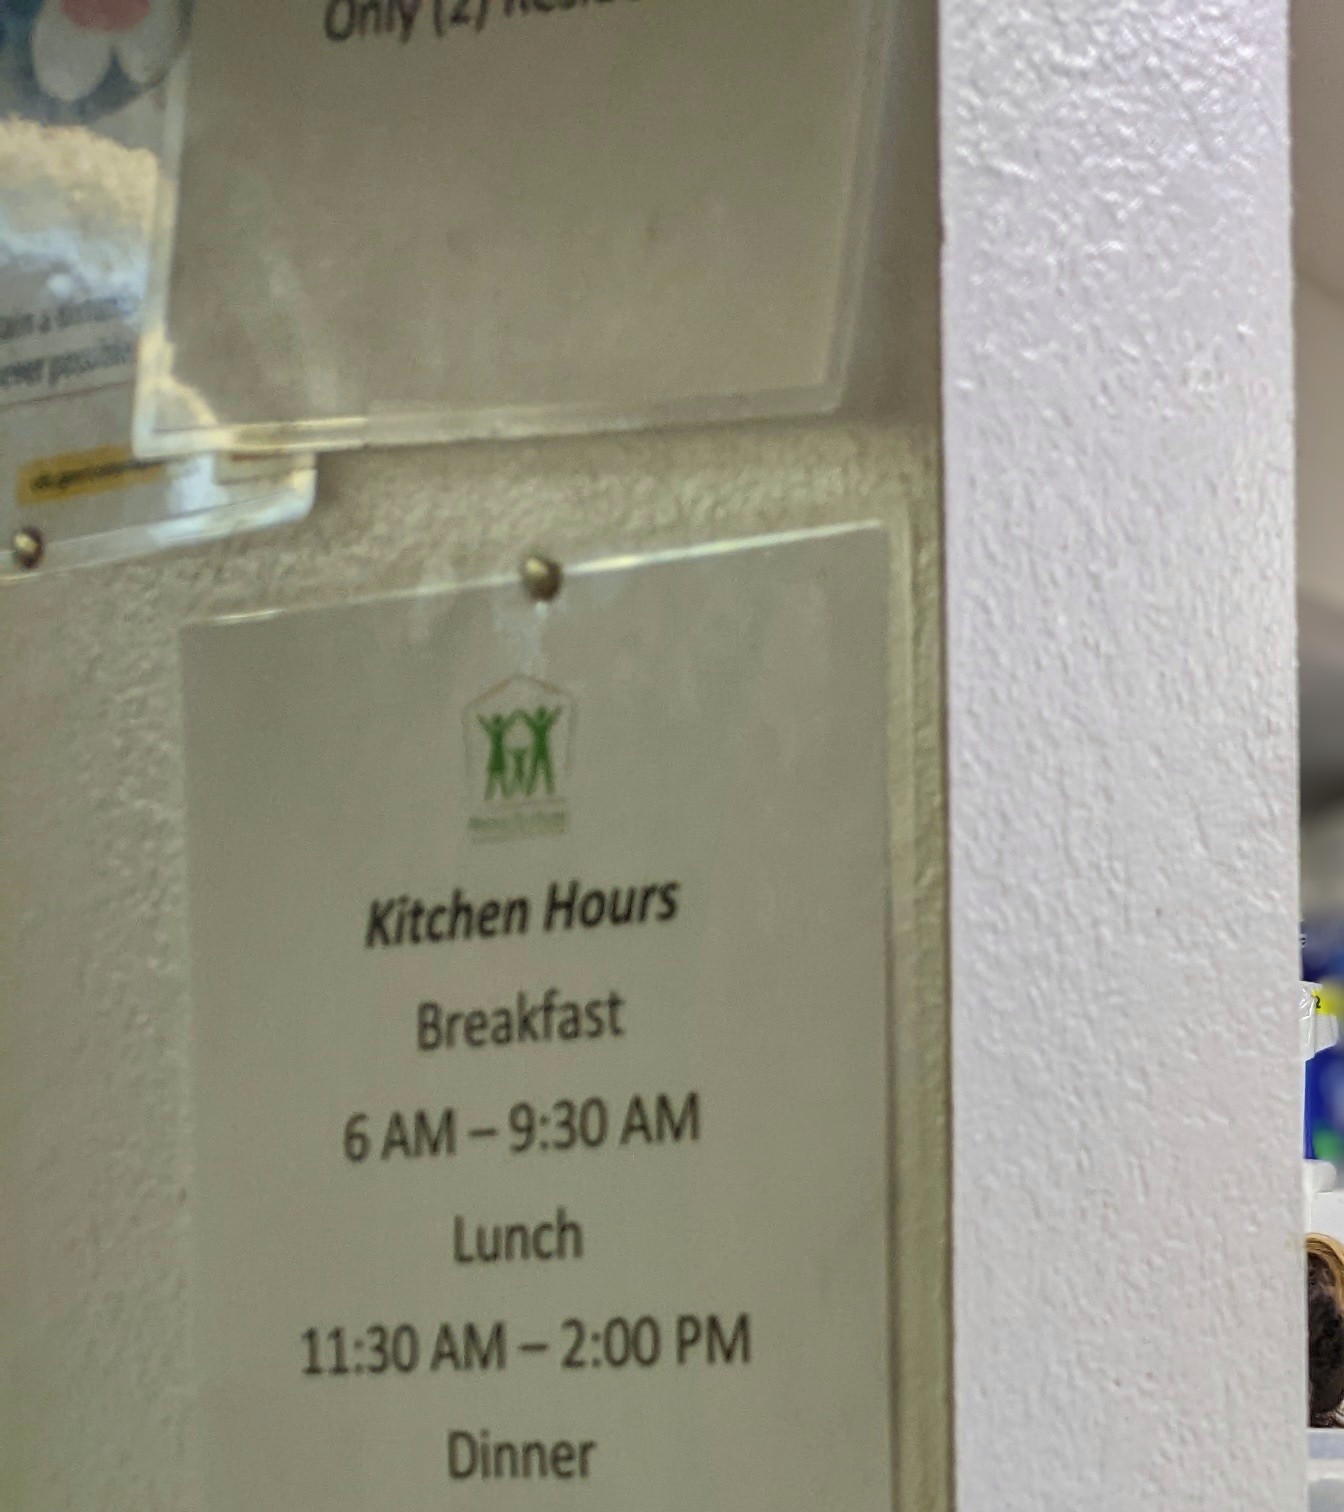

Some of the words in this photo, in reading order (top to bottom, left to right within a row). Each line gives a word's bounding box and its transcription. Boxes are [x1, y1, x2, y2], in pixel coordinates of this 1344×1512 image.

[324, 0, 422, 43] Only
[365, 889, 530, 948] Kitchen
[543, 880, 680, 932] Hours
[416, 987, 625, 1053] Breakfast
[343, 1113, 370, 1163] 6
[381, 1108, 456, 1160] AM
[509, 1097, 608, 1154] 9:30
[620, 1091, 700, 1145] AM
[453, 1208, 583, 1265] Lunch
[301, 1323, 419, 1376] 11:30
[430, 1321, 506, 1371] AM
[561, 1315, 661, 1369] 2:00
[676, 1312, 751, 1365] PM
[447, 1430, 597, 1481] Dinner
